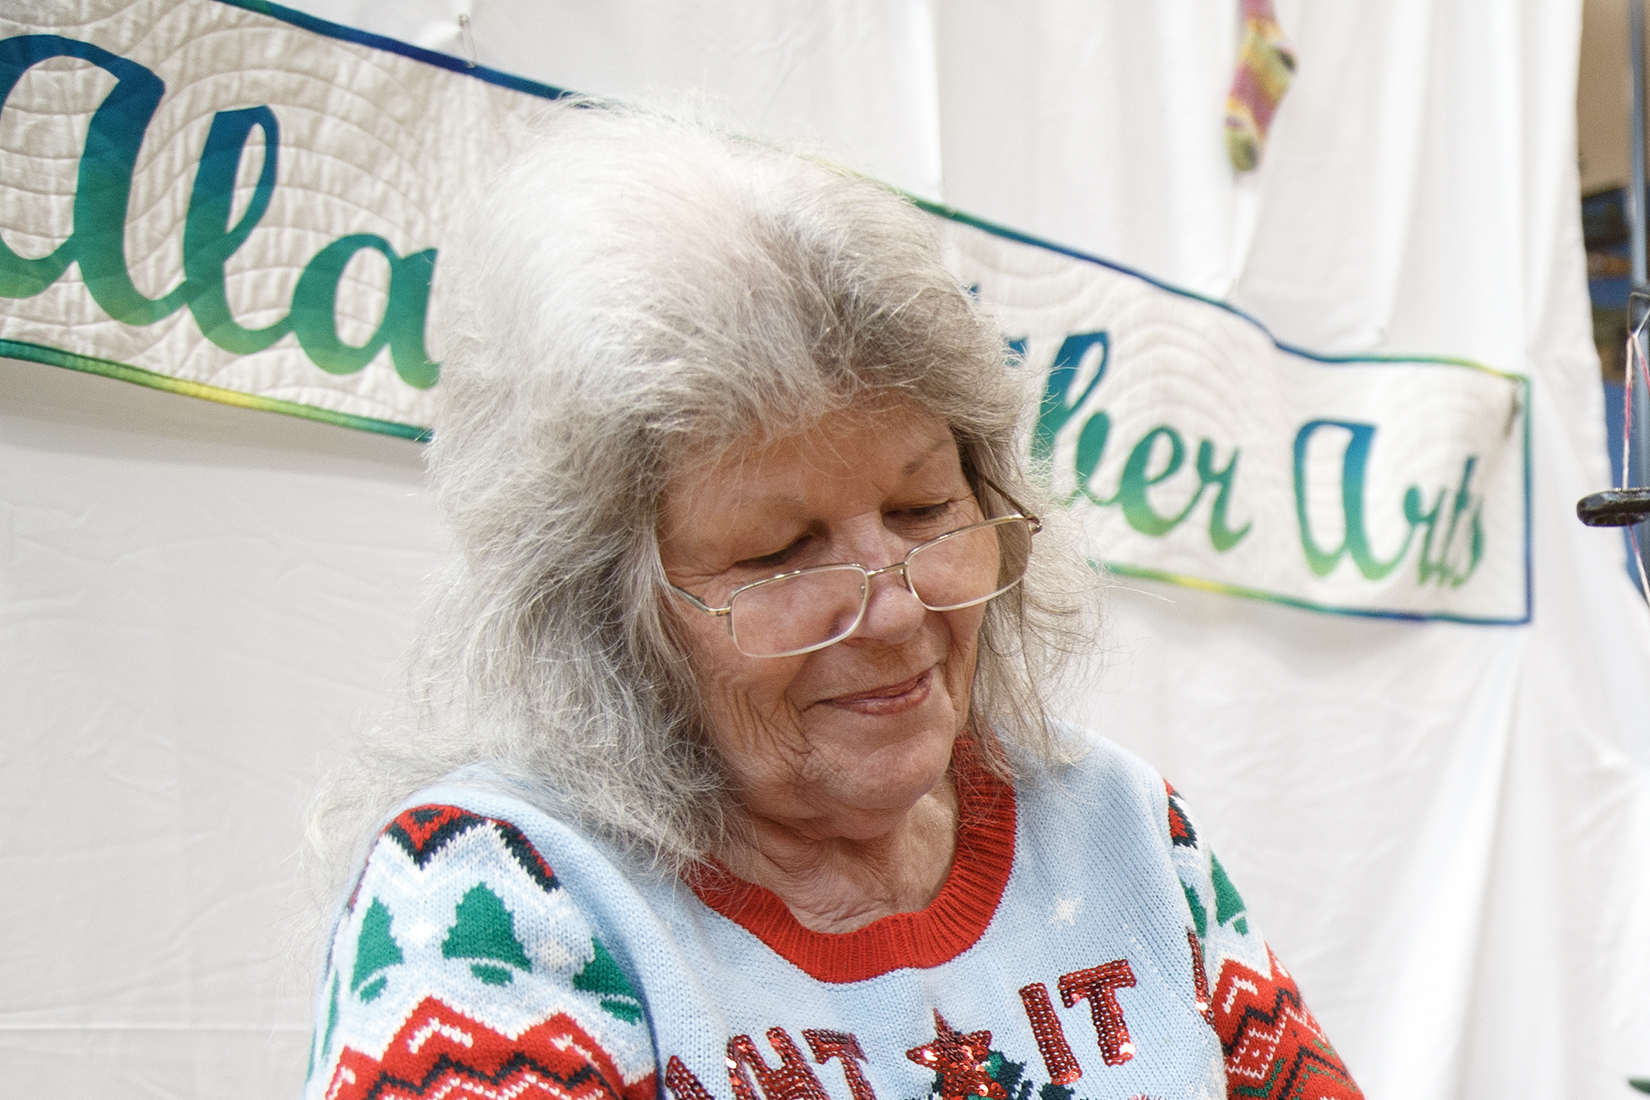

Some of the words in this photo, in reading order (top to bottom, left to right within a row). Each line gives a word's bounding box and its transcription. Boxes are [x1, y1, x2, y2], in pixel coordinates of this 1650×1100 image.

[0, 34, 441, 390] Ala
[1293, 418, 1486, 588] Arts
[1018, 958, 1137, 1086] IT
